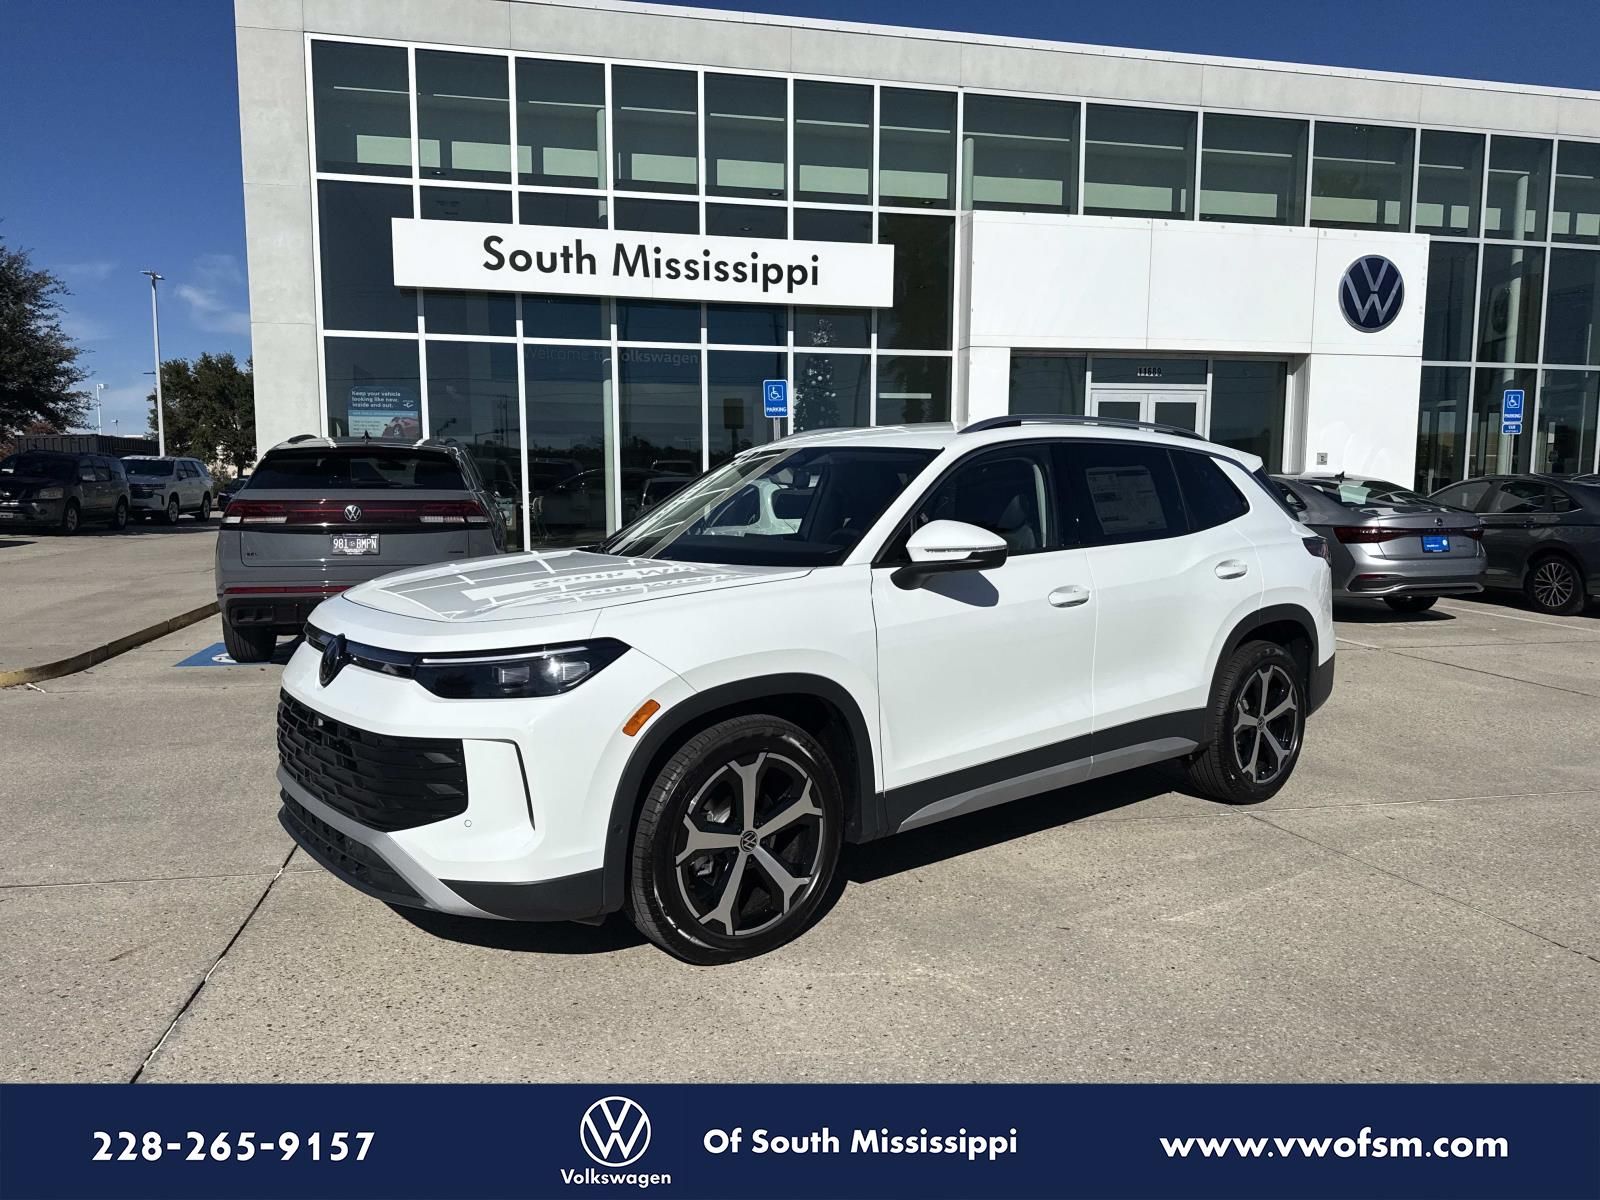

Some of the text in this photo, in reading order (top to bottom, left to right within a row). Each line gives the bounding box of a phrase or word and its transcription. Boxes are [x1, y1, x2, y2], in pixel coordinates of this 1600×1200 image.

[483, 235, 819, 293] South Mississippi
[1338, 254, 1405, 333] VW
[525, 346, 589, 361] Welcome
[617, 349, 699, 366] olkswagen
[333, 538, 349, 549] 981
